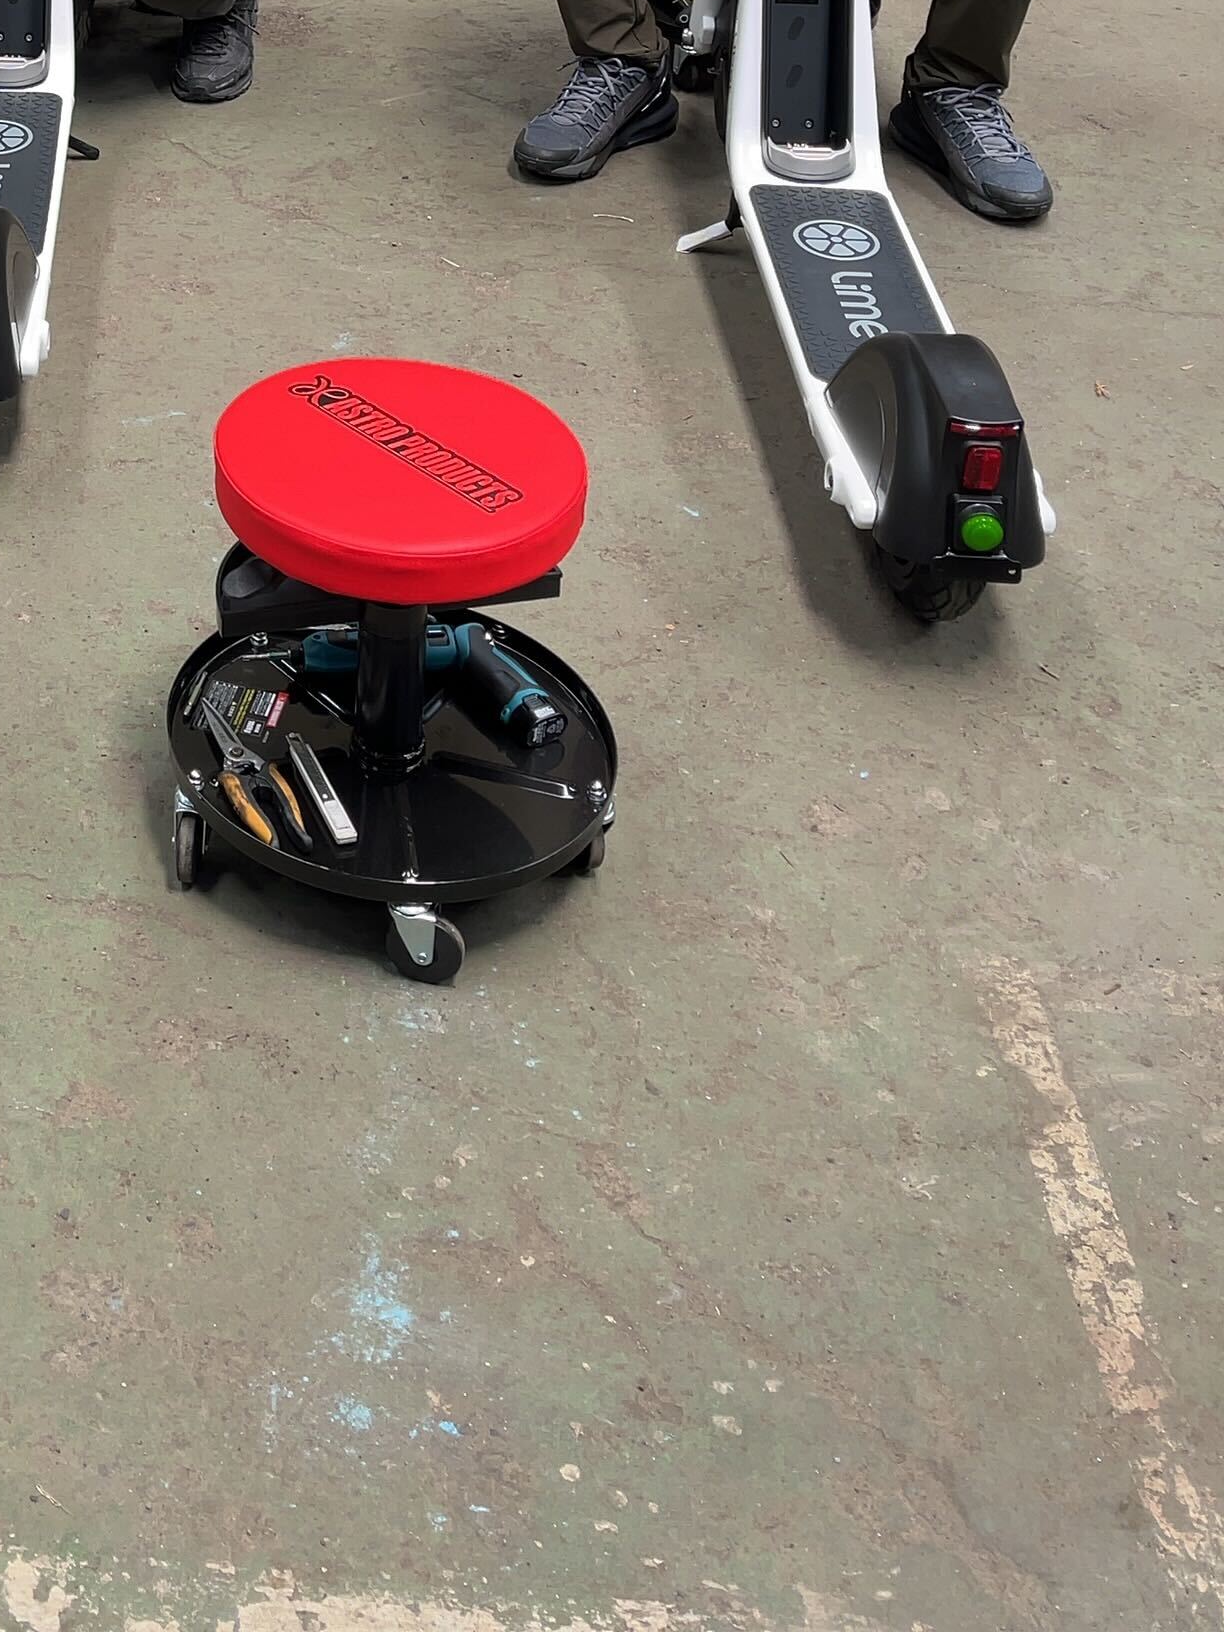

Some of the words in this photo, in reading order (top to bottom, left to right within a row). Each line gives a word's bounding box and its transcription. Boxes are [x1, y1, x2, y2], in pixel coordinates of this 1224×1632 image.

[831, 271, 889, 339] Lime
[325, 396, 411, 447] ASTRO
[395, 432, 522, 511] PRODUCTS
